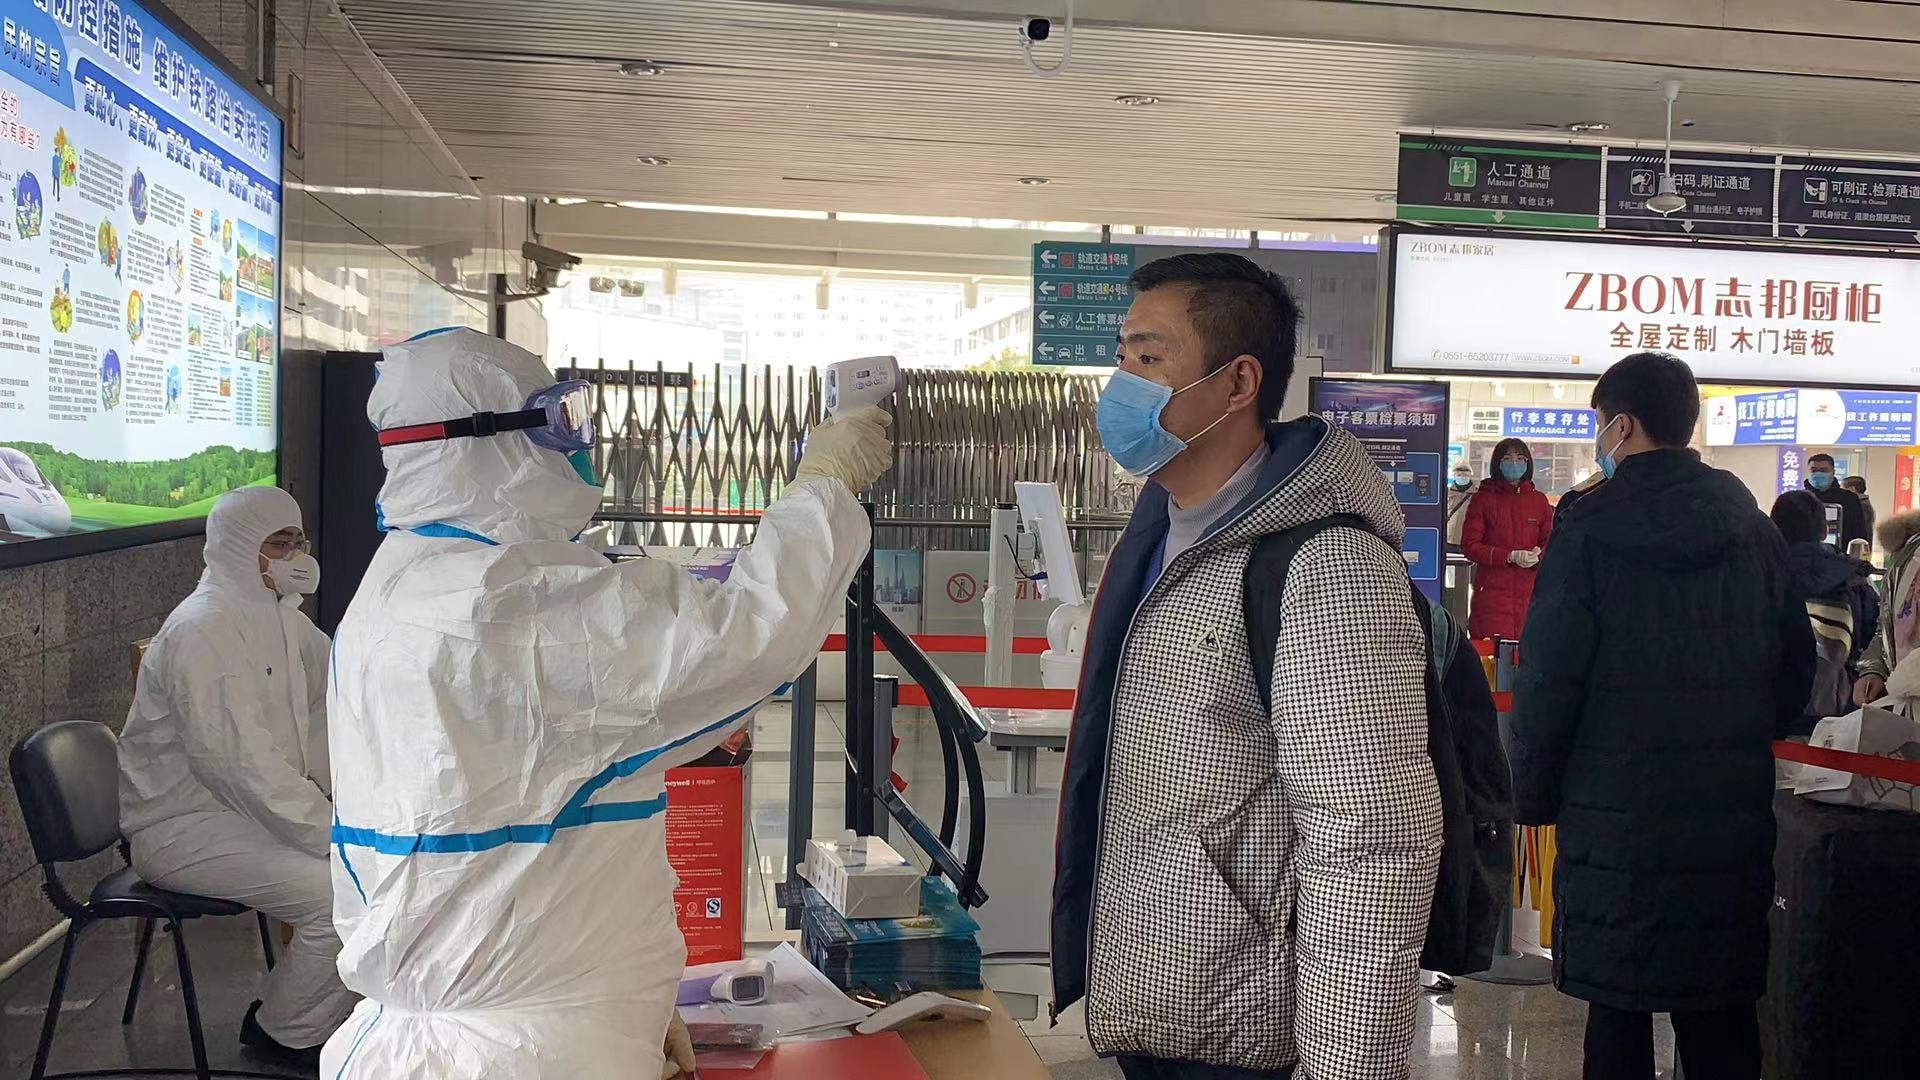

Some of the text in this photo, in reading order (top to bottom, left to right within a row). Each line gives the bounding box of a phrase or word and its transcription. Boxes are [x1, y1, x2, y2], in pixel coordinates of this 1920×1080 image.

[33, 0, 271, 162] 控措施 维护铁路治安秩序
[1487, 161, 1551, 180] 人工通道
[1487, 177, 1549, 189] Manual Channel
[1658, 172, 1751, 191] 扫码、刷证通道
[1831, 181, 1920, 199] 可刷证、检票通道
[1411, 241, 1447, 254] ZBOM
[1564, 271, 1883, 324] ZBOM 志邦厨柜
[1610, 321, 1835, 356] 全屋定制 木门墙板
[1443, 351, 1509, 362] 0551-65203777
[1322, 410, 1436, 426] 电子客票检票须知
[1511, 411, 1590, 426] 行李寄存处
[1781, 450, 1800, 494] 免费
